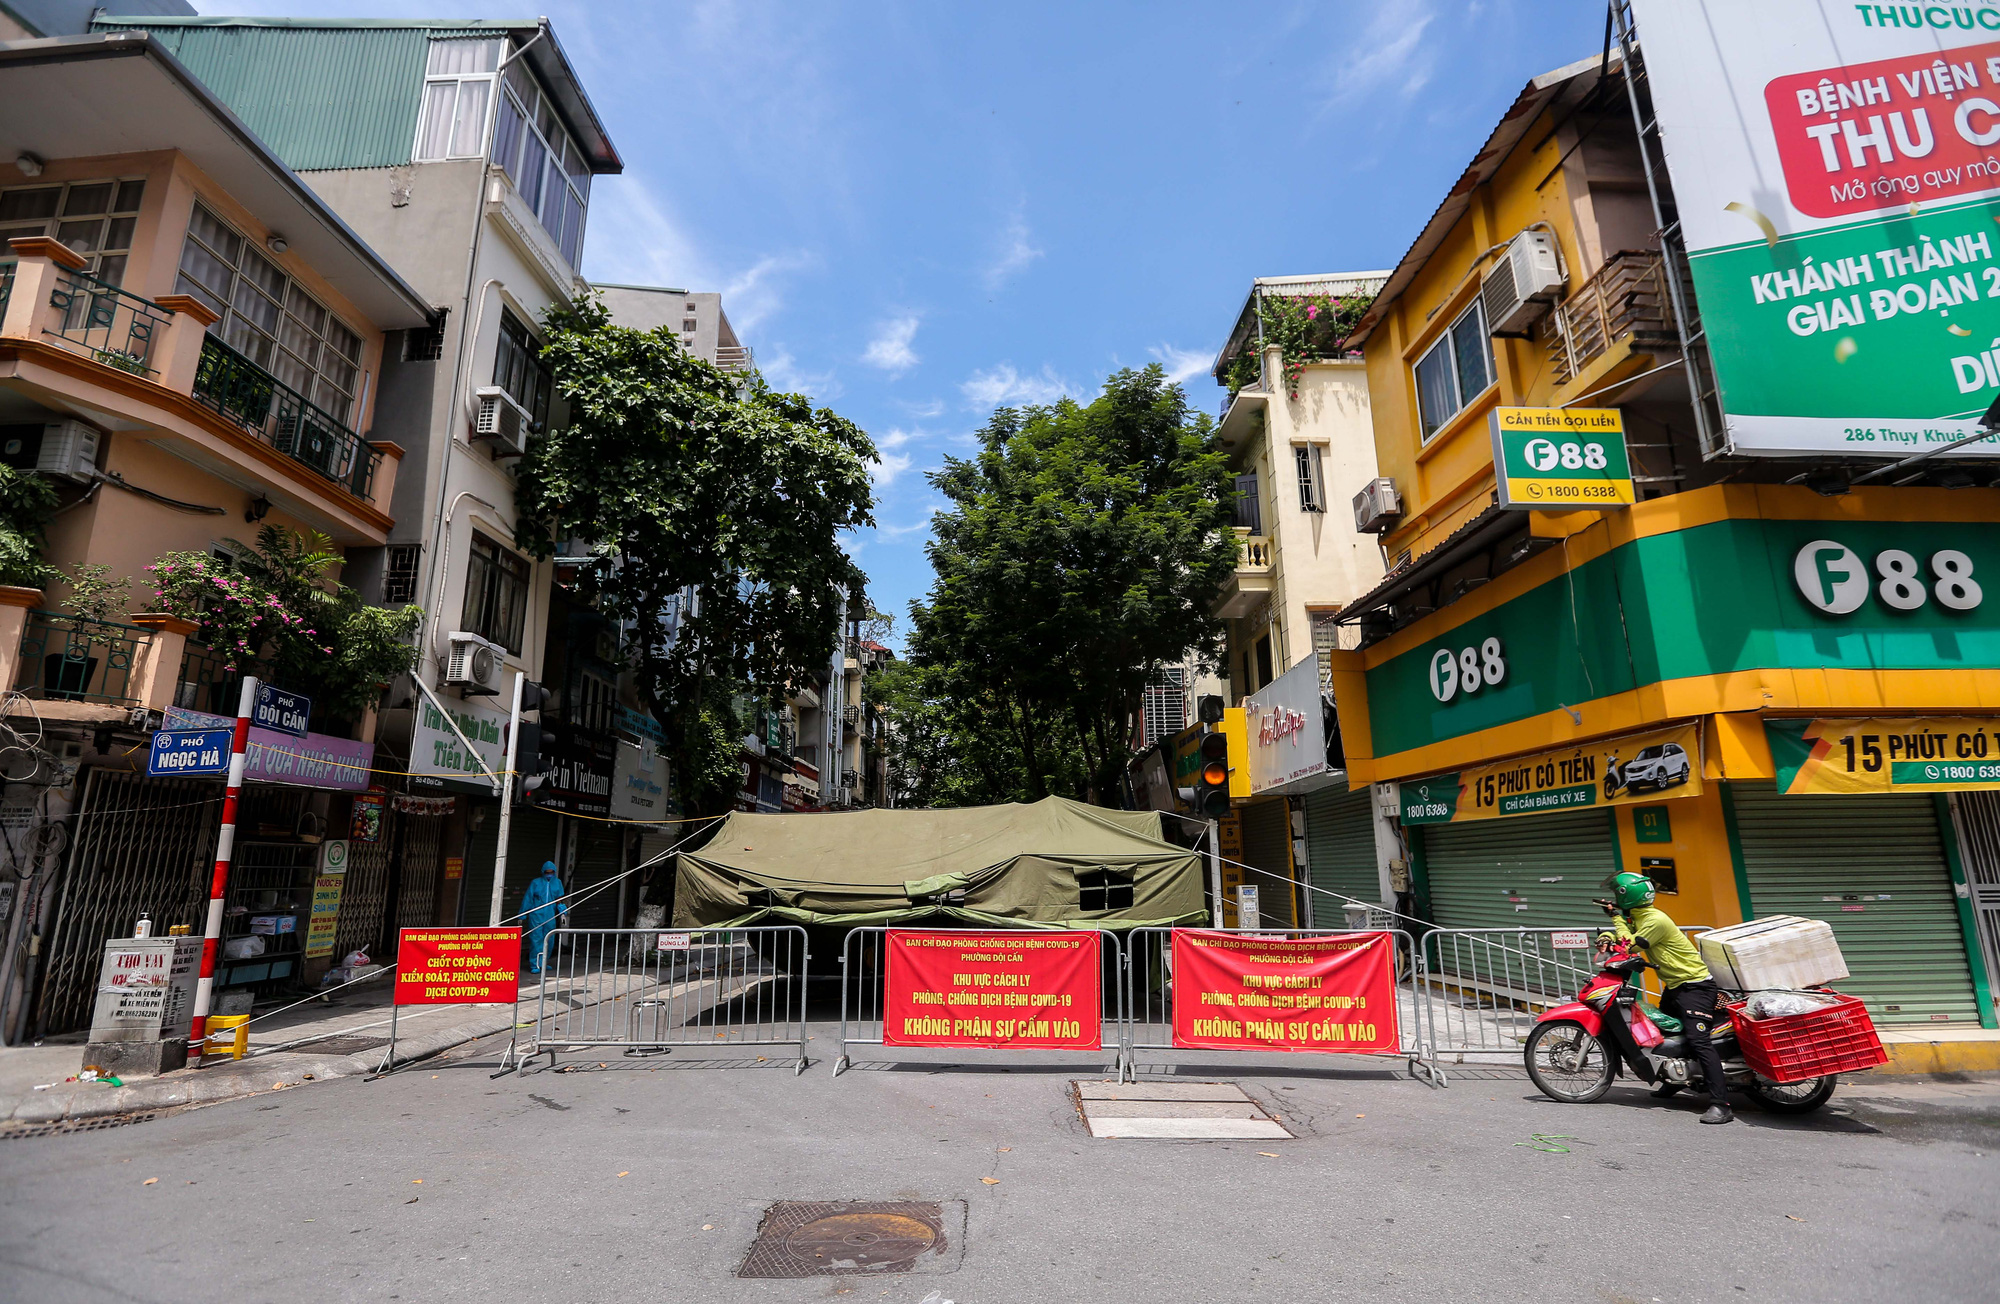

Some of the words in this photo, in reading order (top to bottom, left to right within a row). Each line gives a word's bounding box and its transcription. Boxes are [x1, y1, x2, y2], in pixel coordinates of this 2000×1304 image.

[1796, 78, 1891, 119] BỆNH
[1896, 58, 1979, 100] VIỆN
[1806, 107, 1935, 172] THU
[1830, 179, 1867, 203] Mở
[1870, 176, 1920, 198] rộng
[1923, 166, 1961, 187] quy
[1966, 156, 2000, 178] mô
[1751, 256, 1875, 304] KHÁNH
[1876, 231, 1992, 279] THÀNH
[1787, 294, 1866, 337] GIAI
[1870, 272, 1979, 317] ĐOẠN
[1505, 412, 1532, 425] CẦN
[1536, 412, 1560, 426] TIỀN
[1564, 416, 1587, 429] GỌI
[1844, 428, 1875, 442] 286
[1879, 429, 1918, 446] Thụy
[1523, 438, 1607, 472] F88
[1547, 486, 1579, 497] 1800
[1584, 486, 1616, 497] 6388
[1794, 540, 1984, 615] F88
[1429, 636, 1506, 703] F88
[278, 697, 295, 708] PHỐ
[258, 704, 280, 726] ĐỘI
[282, 709, 306, 731] CẤN
[180, 734, 204, 747] PHỐ
[1839, 735, 1883, 772] 15
[1888, 728, 1948, 759] PHÚT
[1956, 727, 1987, 758] CÓ
[158, 751, 197, 770] NGỌC
[200, 747, 219, 766] HÀ
[265, 738, 297, 775] QUẢ
[298, 747, 333, 785] NHẬP
[334, 746, 369, 784] KHẨU
[559, 758, 570, 789] in
[573, 761, 608, 796] Vietnam
[1475, 774, 1495, 808] 15
[1498, 764, 1531, 795] PHÚT
[1536, 758, 1555, 788] CÓ
[1559, 750, 1596, 785] TIỀN
[1942, 766, 1975, 779] 1800
[1505, 795, 1518, 811] CHỈ
[1536, 793, 1559, 807] ĐĂNG
[1560, 791, 1573, 804] KÝ
[1574, 791, 1586, 803] XE
[1406, 804, 1424, 818] 1800
[1426, 803, 1448, 817] 6388
[1643, 813, 1657, 827] 01
[1226, 827, 1234, 837] 5
[428, 934, 439, 942] ĐẠO
[440, 933, 459, 941] PHÒNG
[460, 932, 478, 941] CHỐNG
[479, 933, 492, 941] DỊCH
[906, 939, 917, 947] BAN
[918, 936, 934, 948] CHỈ
[935, 939, 952, 950] ĐẠO
[953, 938, 979, 948] PHÒNG
[980, 937, 1005, 949] CHỐNG
[1007, 940, 1024, 950] DỊCH
[1025, 939, 1045, 951] BỆNH
[1046, 940, 1079, 949] COVID-19
[1192, 938, 1207, 947] BAN
[1209, 937, 1222, 948] CHỈ
[1241, 940, 1267, 949] PHÒNG
[1269, 940, 1296, 950] CHỐNG
[1297, 942, 1315, 952] DỊCH
[1316, 941, 1336, 952] BỆNH
[438, 942, 460, 950] PHƯỜNG
[461, 943, 470, 951] ĐỘI
[427, 953, 451, 967] CHỐT
[452, 956, 466, 967] CƠ
[466, 954, 492, 969] ĐỘNG
[961, 952, 991, 962] PHƯỜNG
[993, 953, 1006, 964] ĐỘI
[1007, 951, 1023, 962] CẤN
[1250, 953, 1280, 964] PHƯỜNG
[1282, 955, 1296, 966] ĐỘI
[1297, 953, 1314, 964] CẤN
[401, 968, 423, 982] KIỂM
[425, 970, 450, 983] SOÁT,
[452, 969, 482, 982] PHÒNG
[484, 967, 515, 981] CHỐNG
[953, 973, 971, 986] KHU
[973, 973, 992, 988] VỰC
[993, 971, 1017, 987] CÁCH
[1020, 974, 1031, 987] LY
[1243, 975, 1261, 988] KHU
[1263, 975, 1283, 990] VỰC
[1284, 973, 1309, 989] CÁCH
[1311, 976, 1322, 989] LY
[425, 987, 447, 999] DỊCH
[449, 986, 489, 997] COVID-19
[912, 989, 945, 1006] PHÒNG,
[948, 989, 979, 1006] CHỐNG
[980, 993, 1002, 1009] DỊCH
[1004, 991, 1028, 1009] BỆNH
[1031, 994, 1071, 1007] COVID-19
[1201, 991, 1235, 1008] PHÒNG,
[1237, 990, 1269, 1007] CHỐNG
[1272, 995, 1294, 1010] DỊCH
[1296, 993, 1321, 1011] BỆNH
[1323, 996, 1366, 1009] COVID-19
[904, 1015, 950, 1036] KHÔNG
[954, 1016, 992, 1040] PHẬN
[995, 1018, 1016, 1041] SỰ
[1018, 1015, 1049, 1038] CẤM
[1053, 1017, 1080, 1039] VÀO
[1193, 1016, 1241, 1038] KHÔNG
[1246, 1019, 1285, 1043] PHẬN
[1288, 1021, 1310, 1044] SỰ
[1312, 1017, 1345, 1041] CẤM
[1347, 1020, 1376, 1042] VÀO
